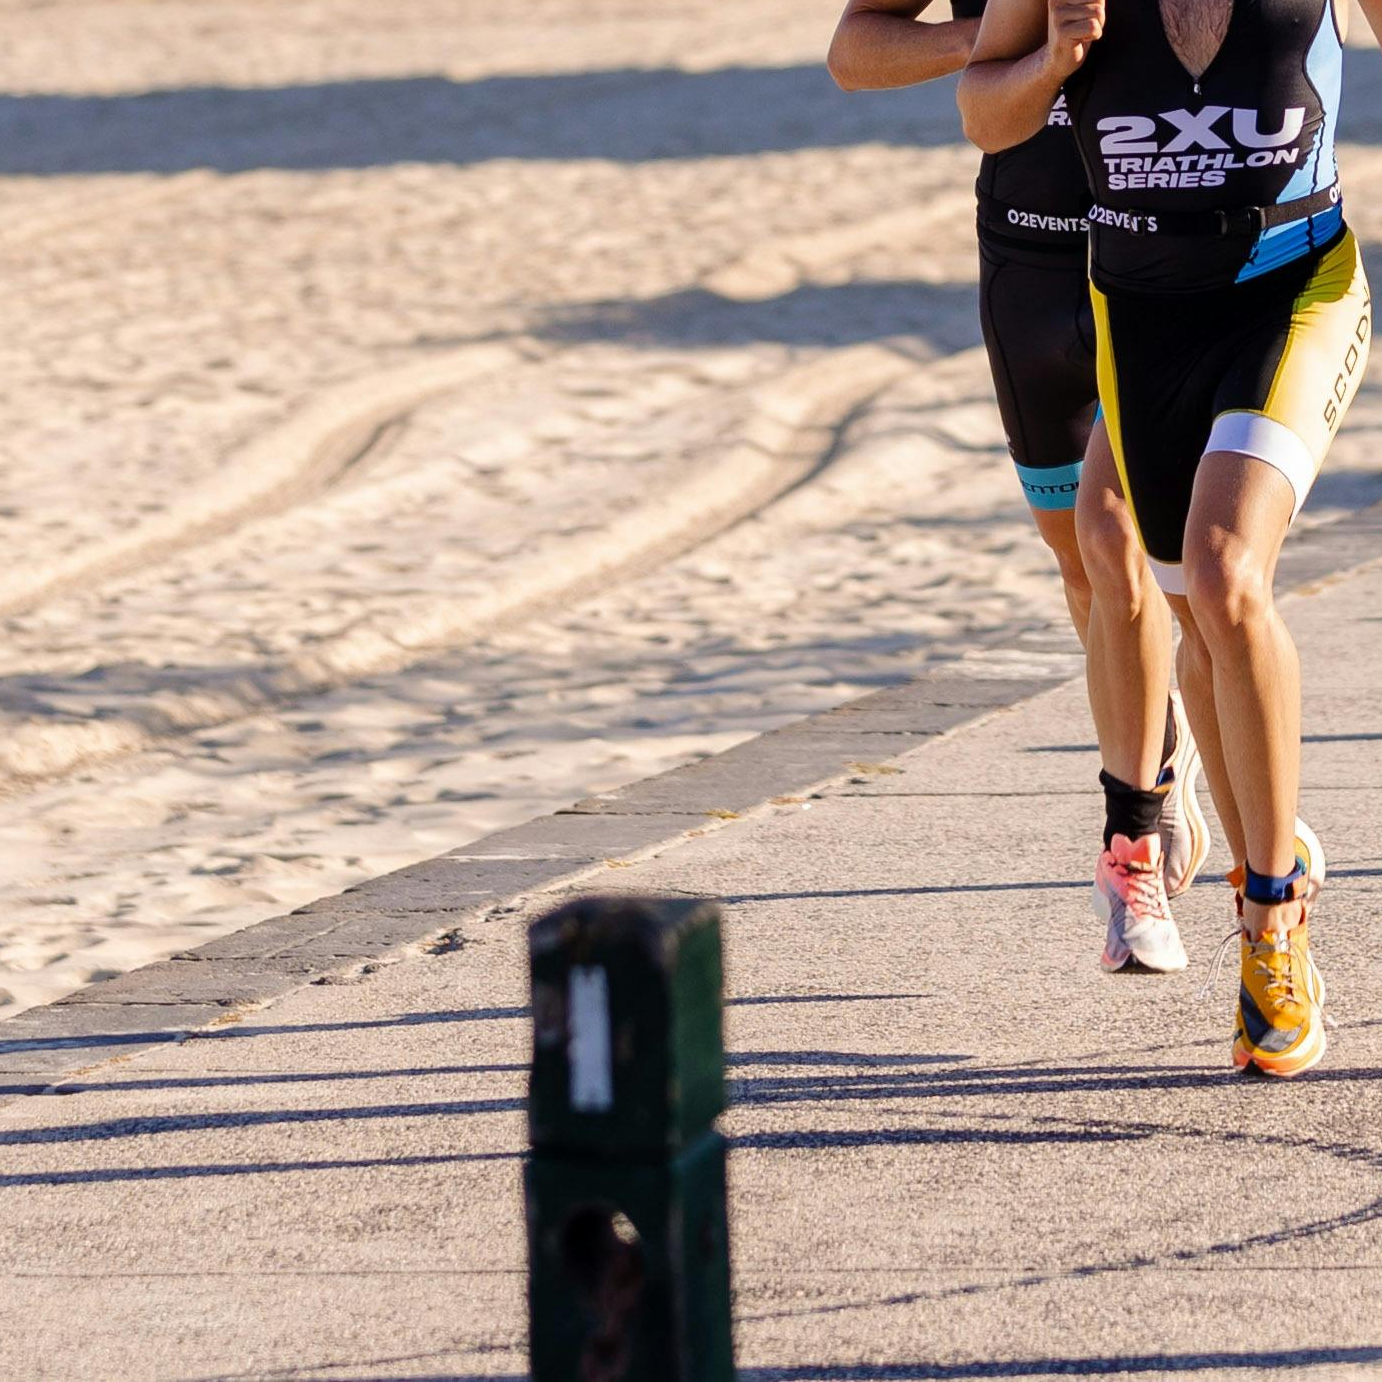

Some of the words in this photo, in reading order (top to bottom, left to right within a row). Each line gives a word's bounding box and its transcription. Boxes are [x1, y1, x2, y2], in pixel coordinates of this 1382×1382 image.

[1096, 105, 1306, 155] 2XU
[1104, 147, 1299, 173] TRIATHLON
[1108, 170, 1226, 190] SERIES
[1007, 209, 1090, 231] O2EVENTS
